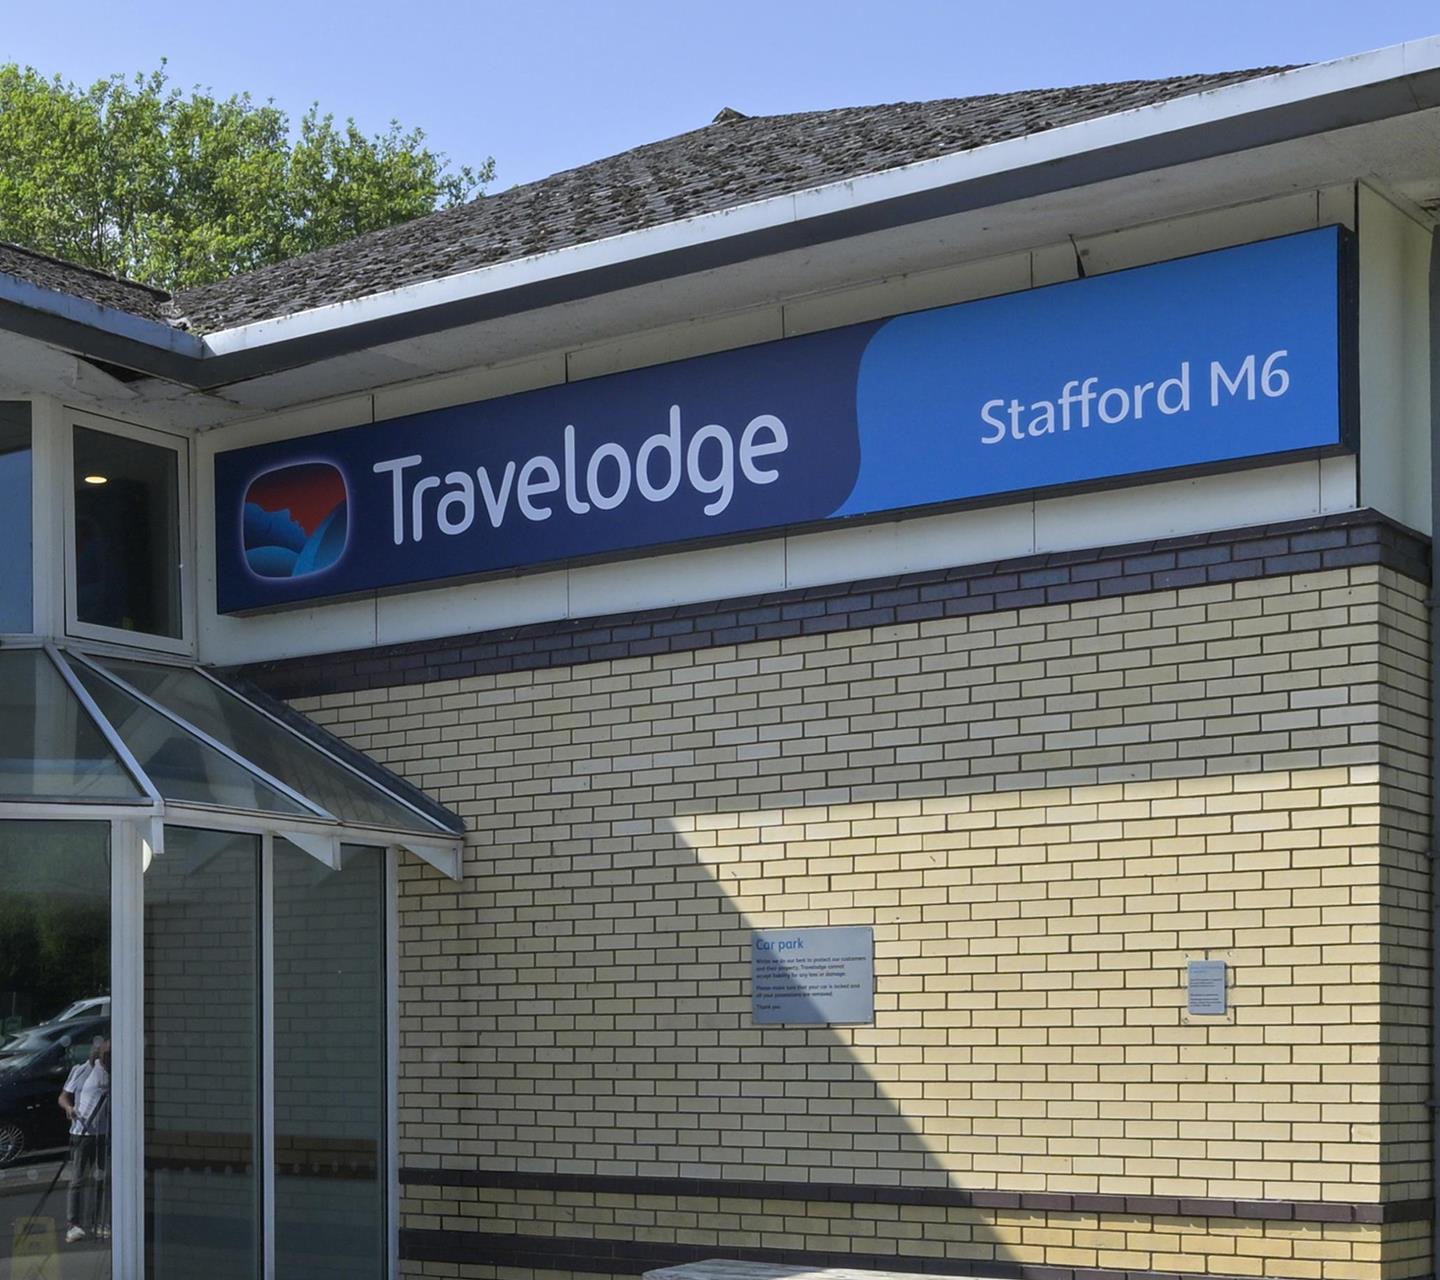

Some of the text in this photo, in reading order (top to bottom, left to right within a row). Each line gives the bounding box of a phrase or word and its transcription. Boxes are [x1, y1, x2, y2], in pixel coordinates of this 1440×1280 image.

[982, 351, 1289, 443] Stafford M6
[372, 404, 789, 545] Travelodge
[756, 938, 804, 952] Car park
